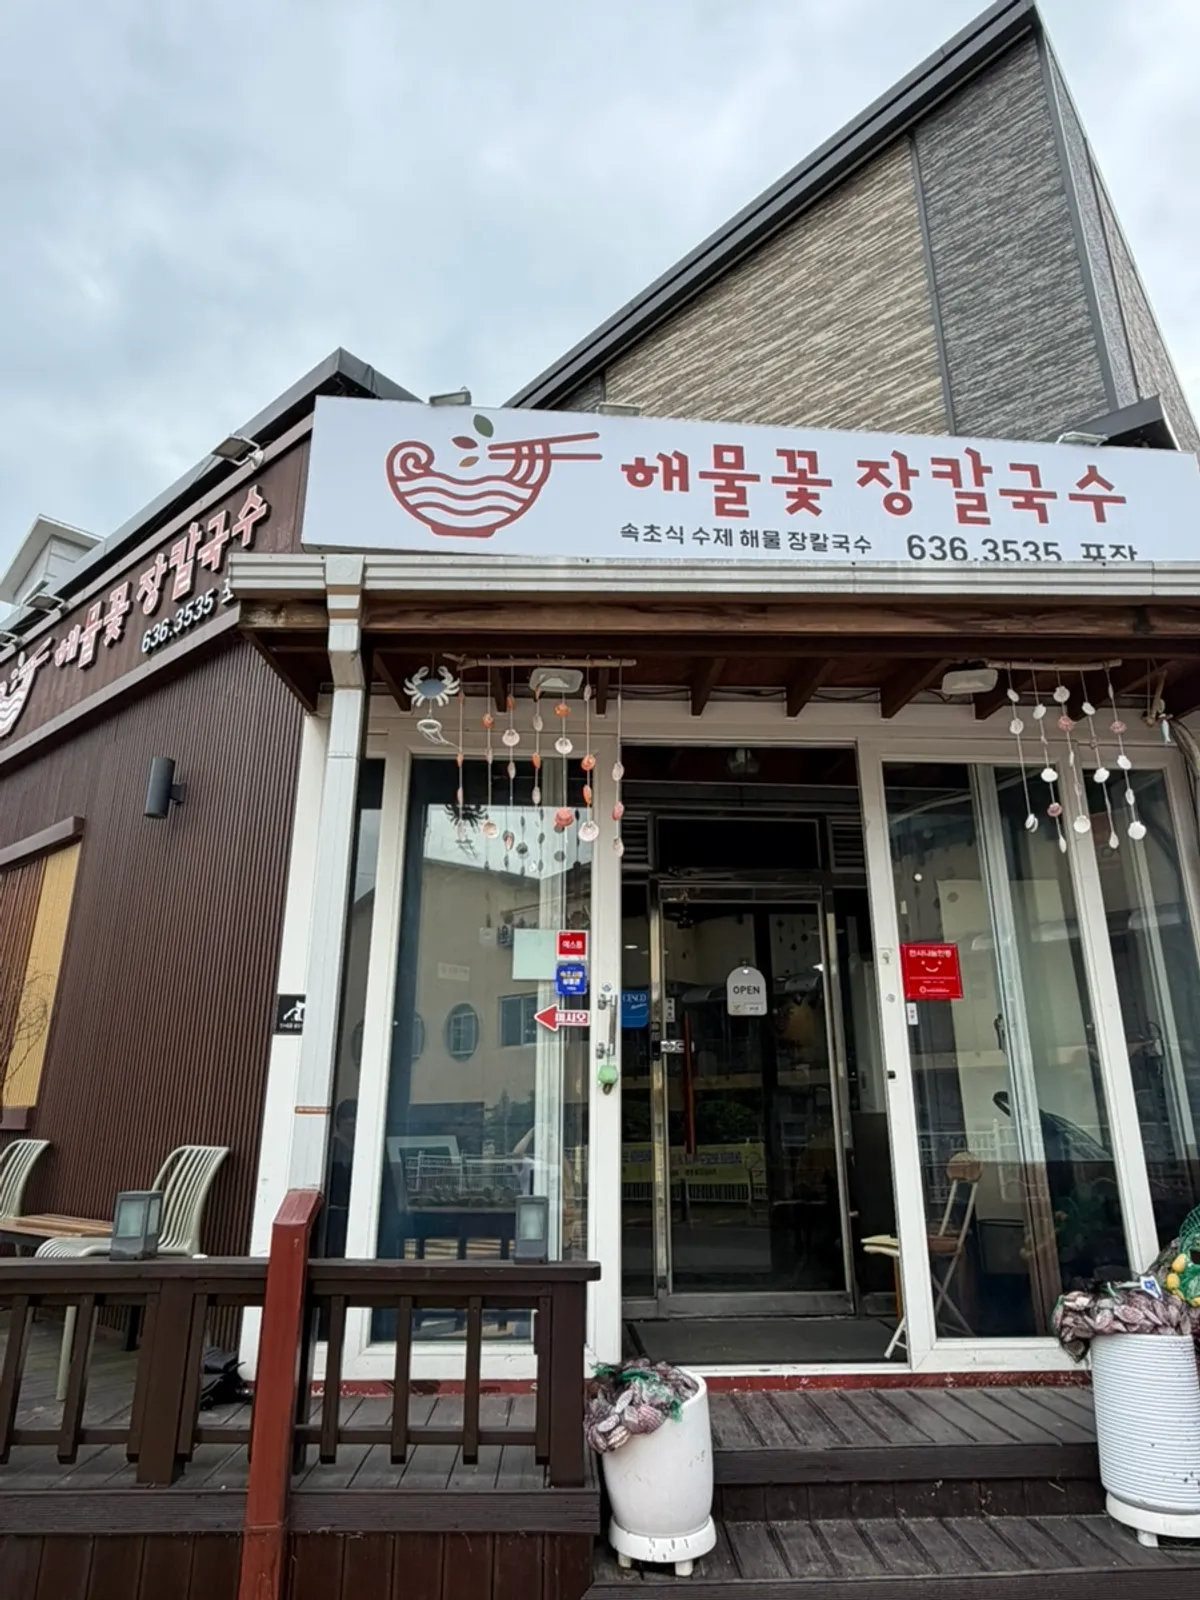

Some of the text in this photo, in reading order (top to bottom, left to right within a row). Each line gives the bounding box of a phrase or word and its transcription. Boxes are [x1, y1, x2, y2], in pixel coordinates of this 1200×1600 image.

[620, 443, 1127, 525] 해물꽃 장칼국수
[619, 523, 872, 554] 속초식 수제 해물 장칼국수
[906, 534, 1063, 562] 636.3535
[54, 484, 269, 668] 해물꽃 장칼국수
[141, 588, 218, 653] 636.3535
[732, 985, 761, 995] OPEN
